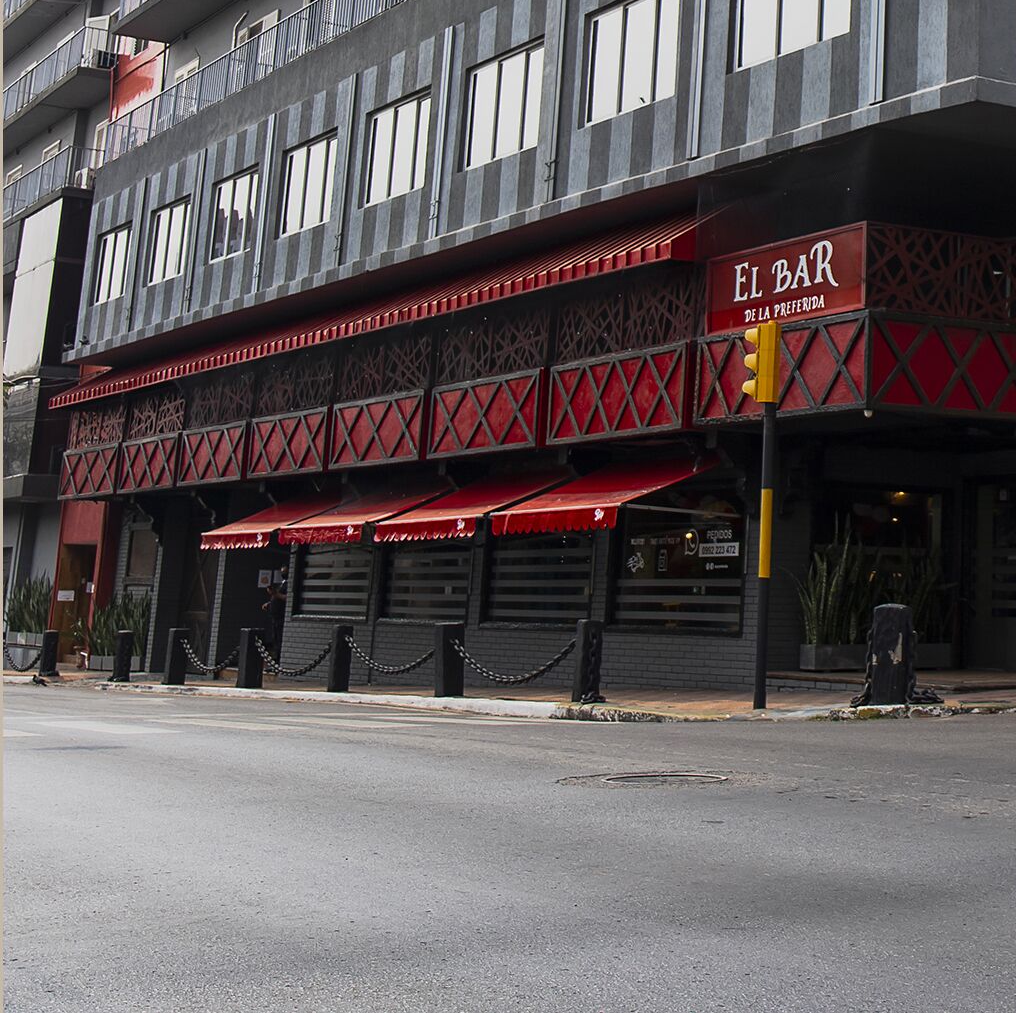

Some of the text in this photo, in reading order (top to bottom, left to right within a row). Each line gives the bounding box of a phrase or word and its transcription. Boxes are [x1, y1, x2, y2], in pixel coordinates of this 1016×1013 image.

[733, 240, 839, 302] EL BAR
[744, 294, 825, 323] DE LA PREFERIDA
[707, 529, 733, 539] PEDIDOS
[715, 545, 725, 555] 223
[726, 545, 736, 555] 472
